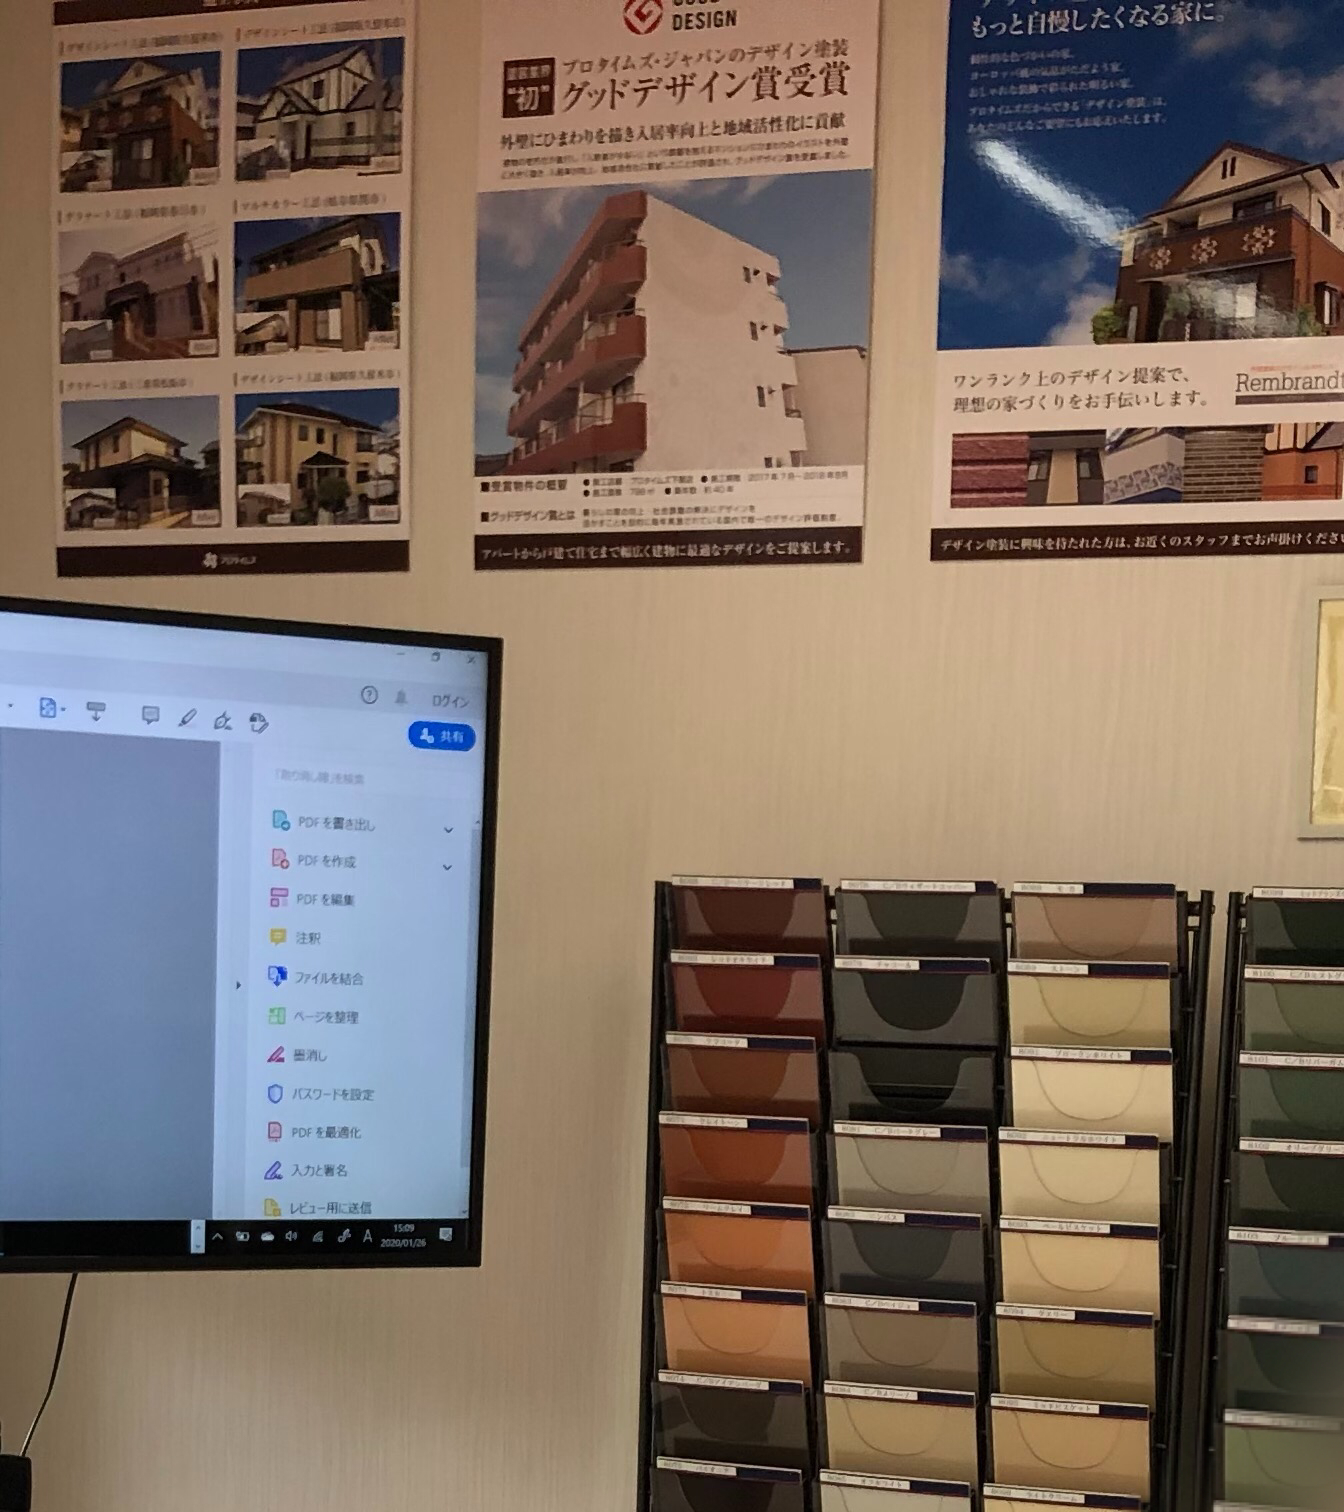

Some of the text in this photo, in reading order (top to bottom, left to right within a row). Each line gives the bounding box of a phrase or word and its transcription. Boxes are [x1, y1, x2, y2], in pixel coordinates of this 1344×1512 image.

[671, 10, 738, 31] DESIGN
[972, 2, 1226, 38] もっと自慢したくなる家に。
[563, 38, 849, 75] プロタイムズ・ジャパンのデザイン塗装
[561, 61, 850, 112] グッドデザイン賞受賞
[516, 86, 540, 112] 初
[953, 368, 1191, 389] ワンランク上のデザイン提案で、
[953, 391, 1209, 413] 理想の家づくりをお手伝いします。
[298, 816, 320, 829] PDF
[297, 854, 357, 869] PDF を作成
[296, 893, 355, 907] PDF を編集
[295, 931, 321, 945] 注釈
[295, 971, 364, 986] ファイルを結合
[293, 1010, 359, 1025] ページを整理
[292, 1088, 375, 1102] パスワードを設定
[292, 1126, 362, 1139] PDF を最適化
[290, 1163, 348, 1178] 入力と署名
[289, 1201, 372, 1215] レビュー用に送信
[362, 1229, 373, 1243] A
